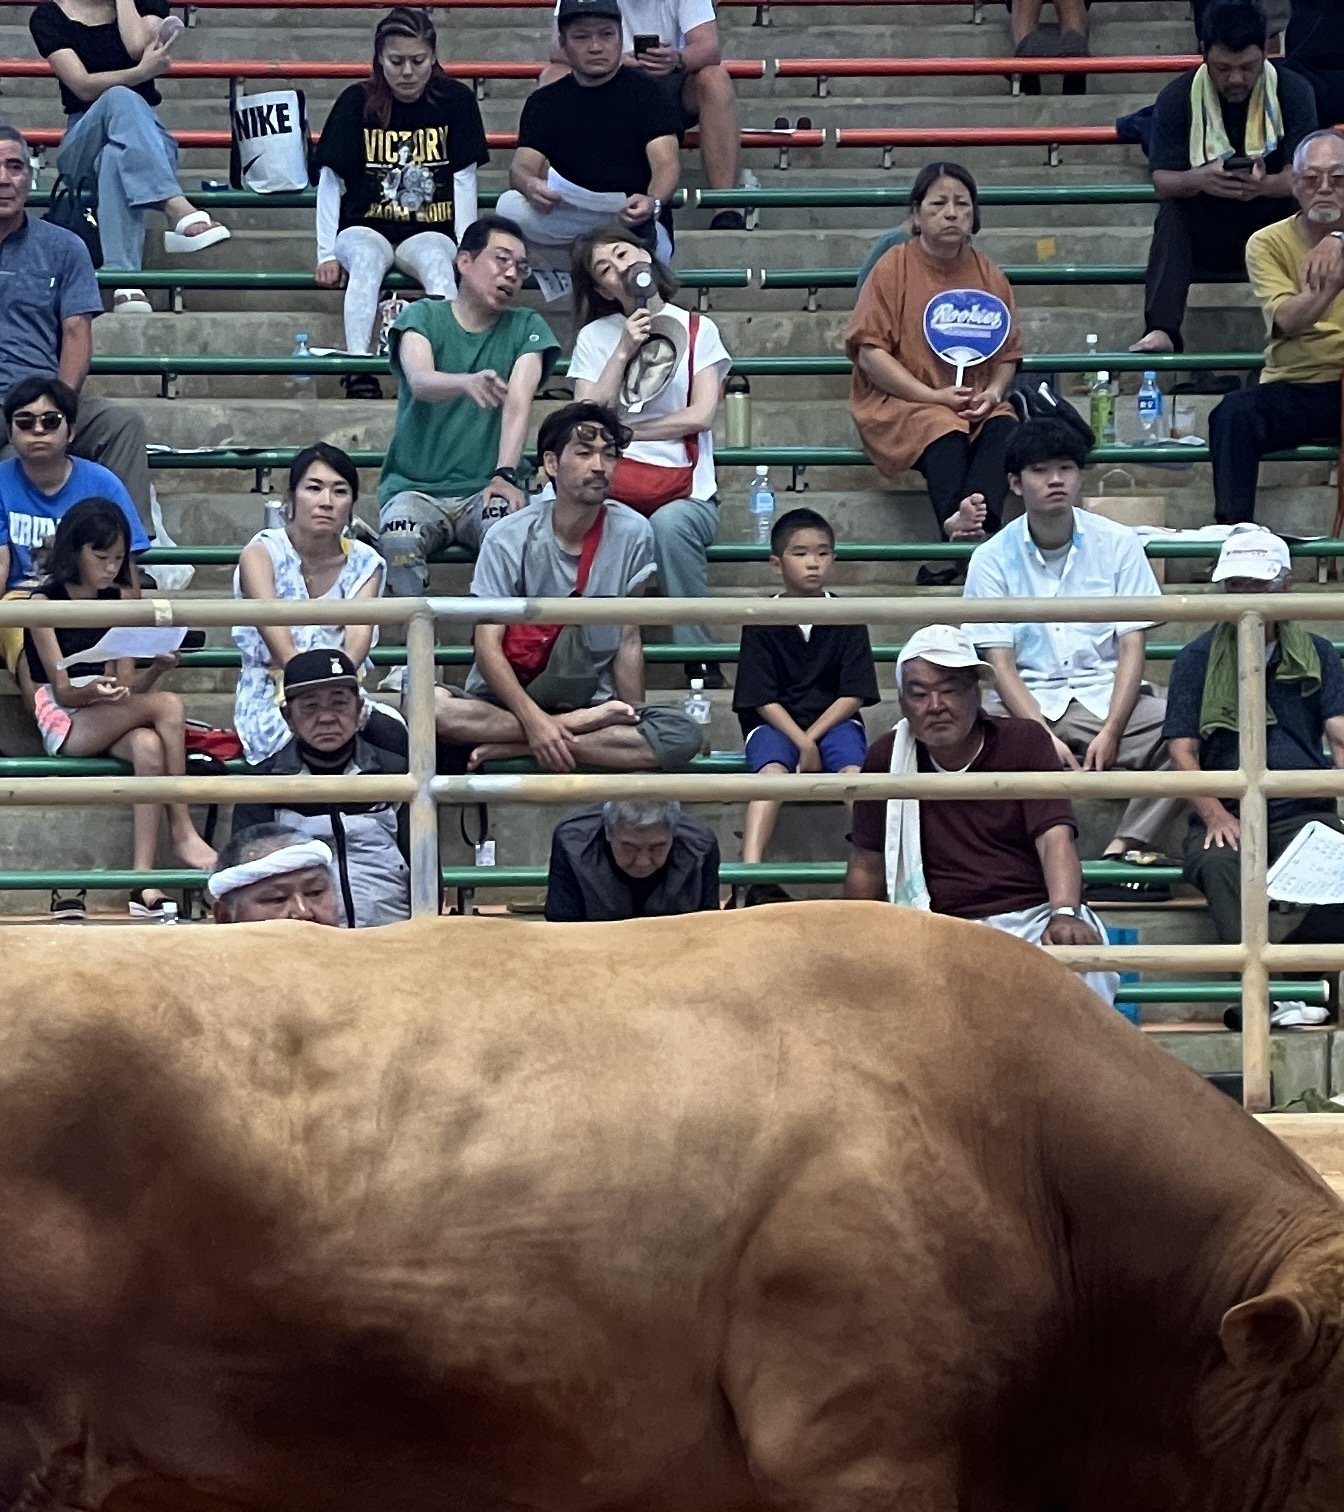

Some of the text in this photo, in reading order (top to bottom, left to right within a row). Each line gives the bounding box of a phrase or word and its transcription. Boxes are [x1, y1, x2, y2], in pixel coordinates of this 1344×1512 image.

[235, 103, 293, 141] NIKE
[363, 125, 448, 163] VICTORY
[931, 303, 1003, 329] Rookies
